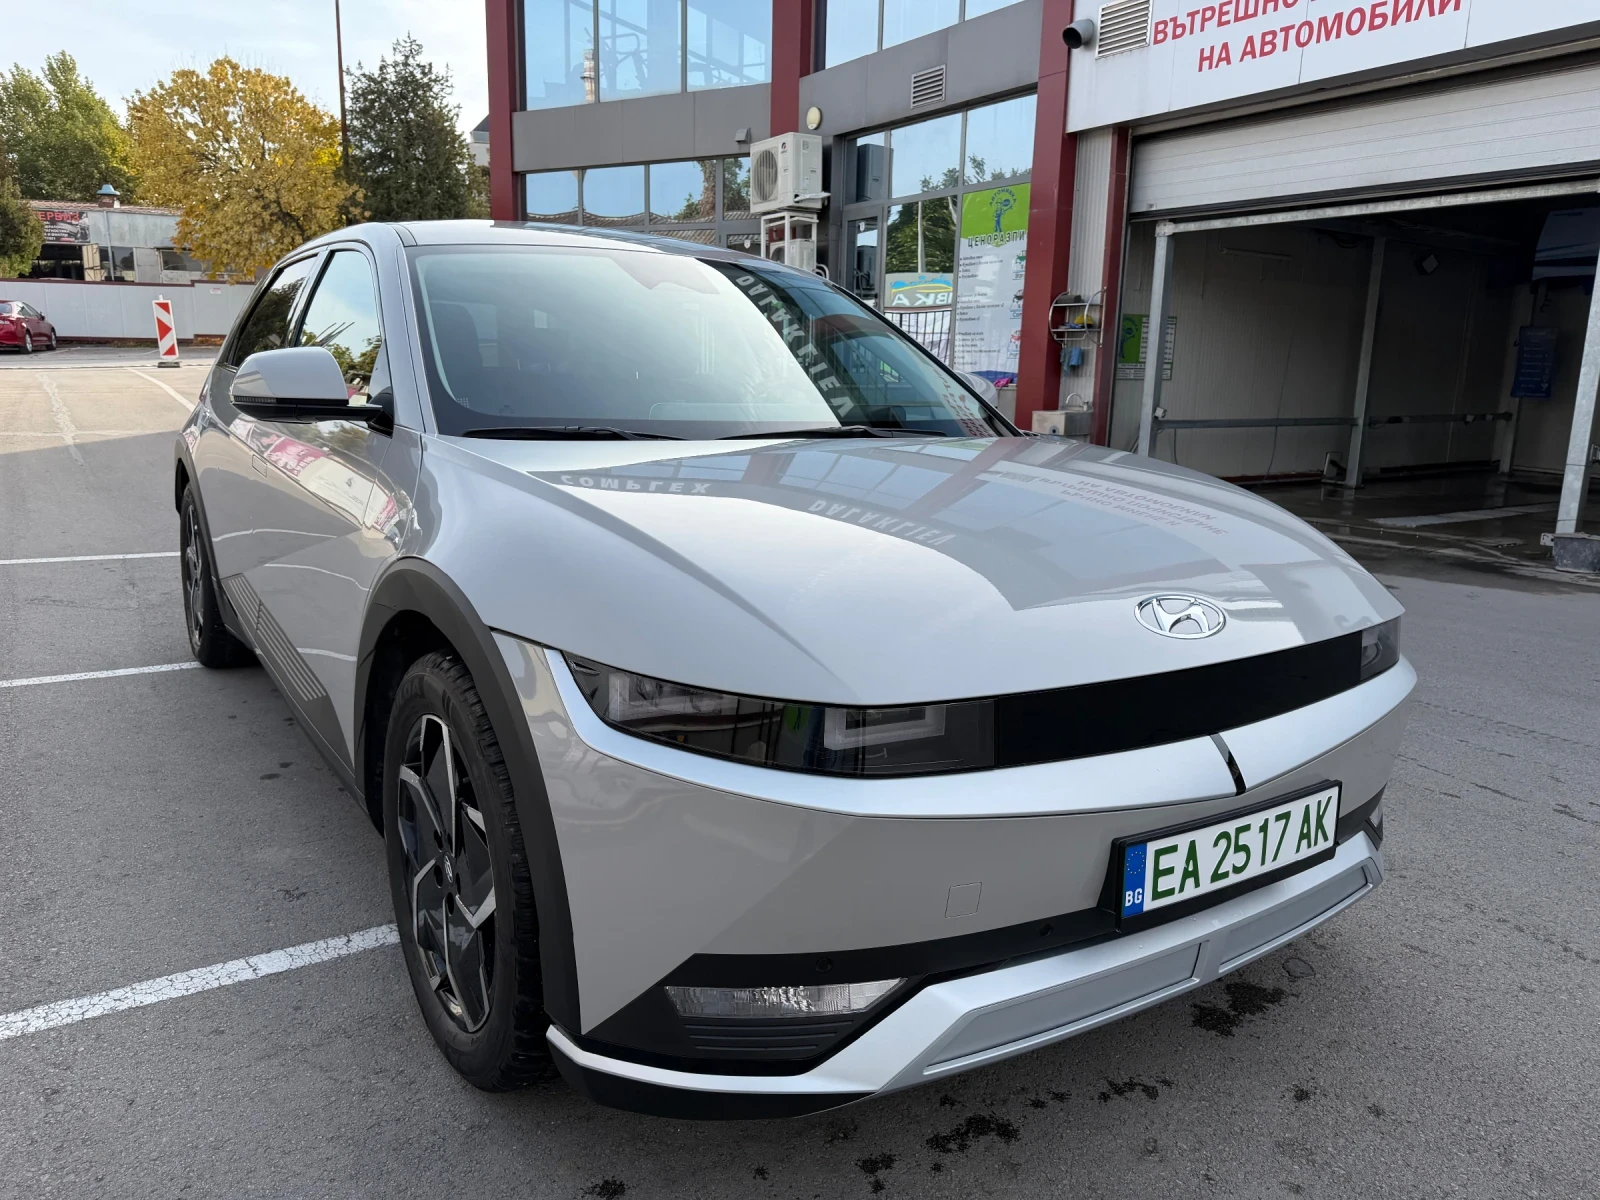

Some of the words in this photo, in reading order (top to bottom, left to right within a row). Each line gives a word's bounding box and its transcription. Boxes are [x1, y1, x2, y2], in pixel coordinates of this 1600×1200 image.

[1197, 42, 1231, 72] НА
[968, 229, 1026, 248] ЦЕНОРАЗПИ
[1125, 888, 1143, 907] BG
[1151, 839, 1201, 901] EA
[1210, 811, 1292, 884] 2517
[1295, 795, 1333, 855] AK
